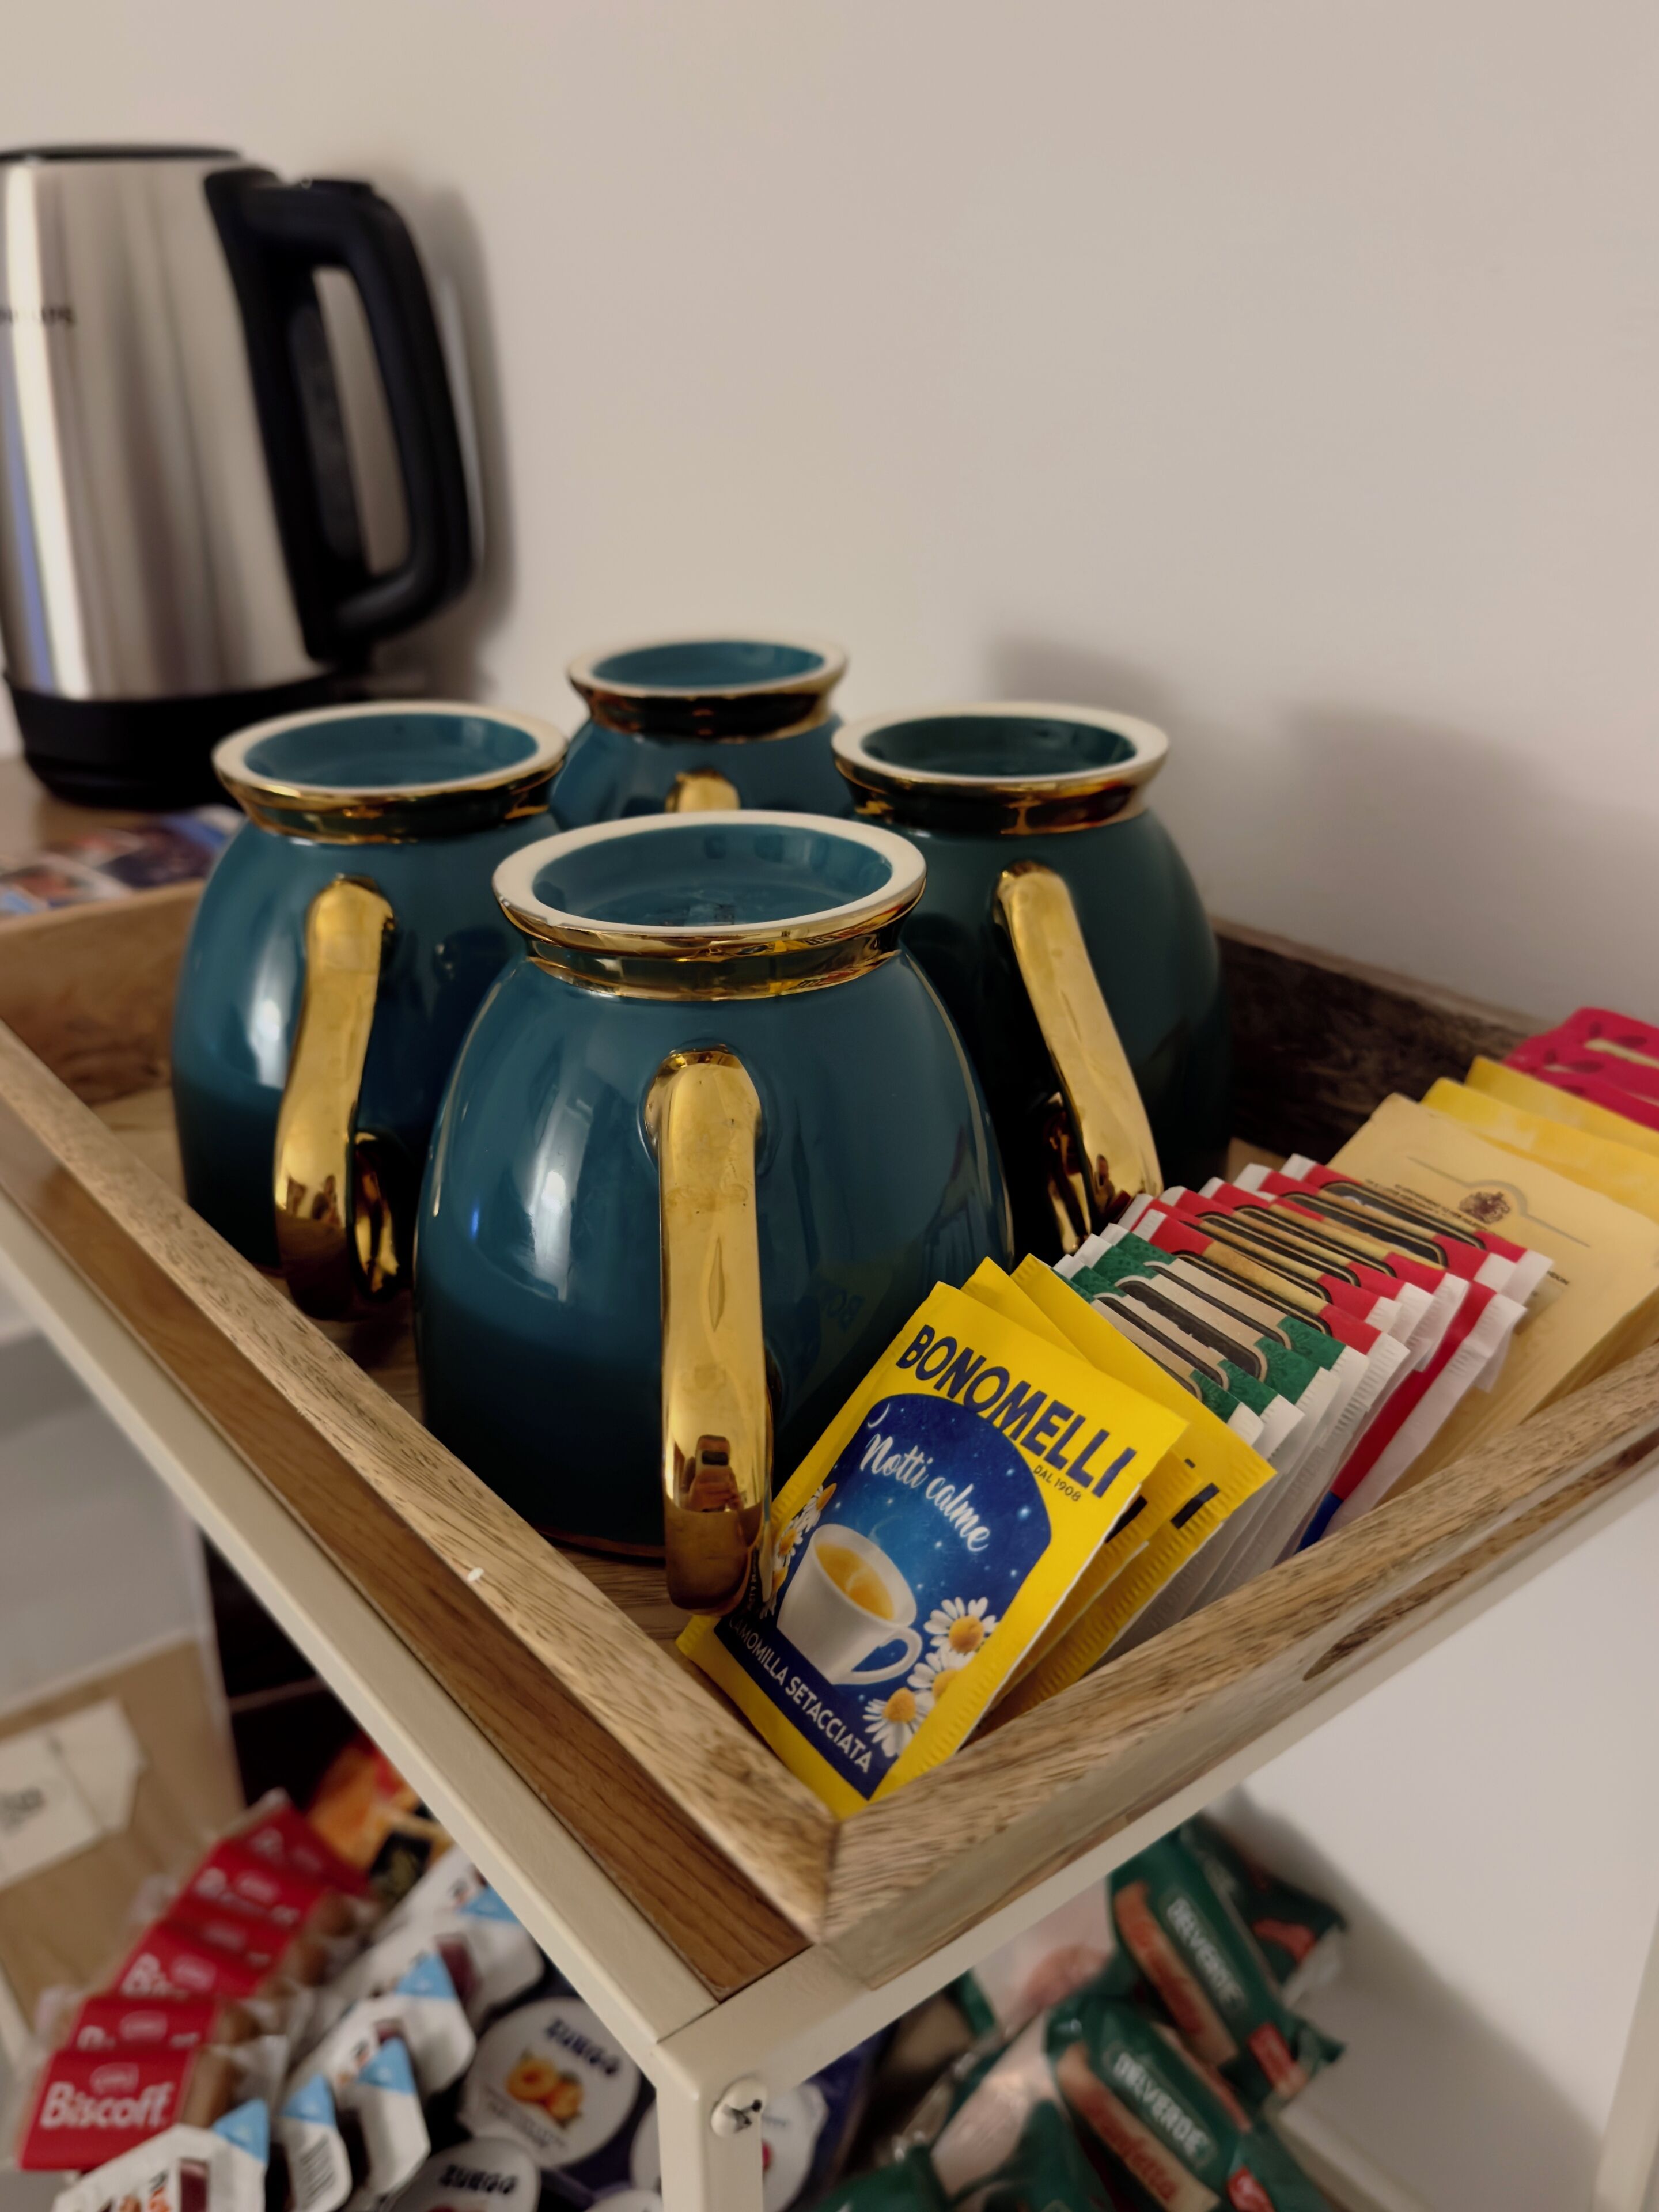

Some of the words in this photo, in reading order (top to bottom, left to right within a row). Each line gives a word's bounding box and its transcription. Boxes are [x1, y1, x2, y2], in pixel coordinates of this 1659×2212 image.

[895, 1324, 1137, 1498] BONOMELLI
[860, 1434, 933, 1488] Notti
[925, 1483, 990, 1552] calme
[1033, 1465, 1052, 1483] DAL
[1054, 1478, 1081, 1502] 1908
[729, 1615, 789, 1685] CAMOMILLA
[785, 1676, 872, 1773] SETACCIATA
[39, 2081, 174, 2128] Biscoff
